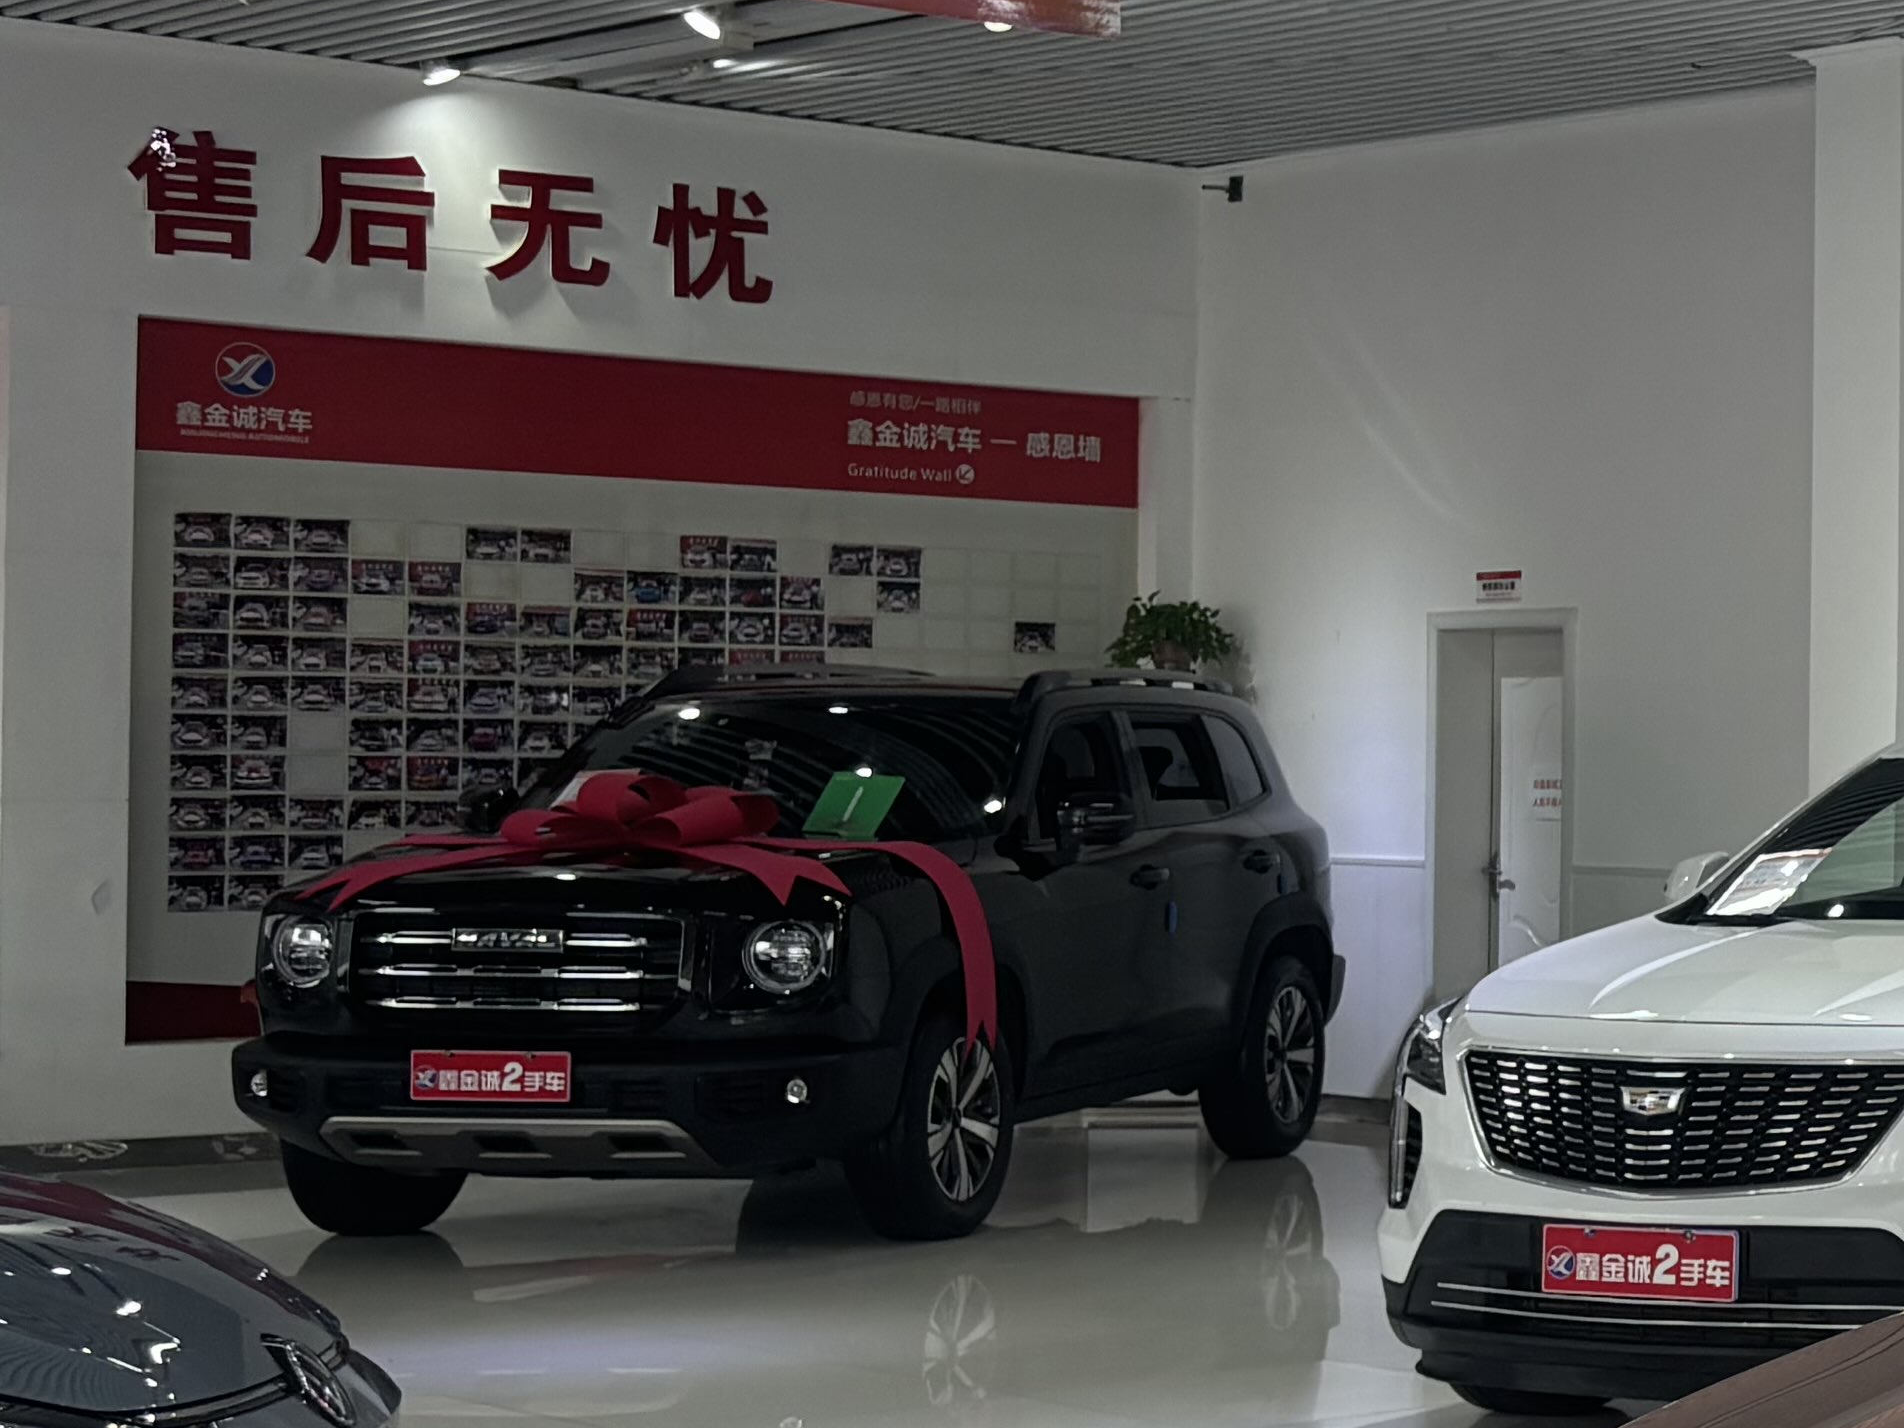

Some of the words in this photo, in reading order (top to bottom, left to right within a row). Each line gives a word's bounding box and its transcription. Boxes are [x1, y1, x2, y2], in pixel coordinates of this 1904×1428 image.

[129, 127, 774, 304] 售后无忧
[176, 401, 312, 433] 鑫金诚汽车
[847, 419, 982, 453] 鑫金诚汽车
[1026, 432, 1101, 462] 感恩墙
[848, 463, 917, 481] Gratitude
[921, 468, 952, 482] Wall
[438, 1062, 565, 1092] 鑫金诚2手车
[1576, 1243, 1730, 1287] 鑫金诚2手车
